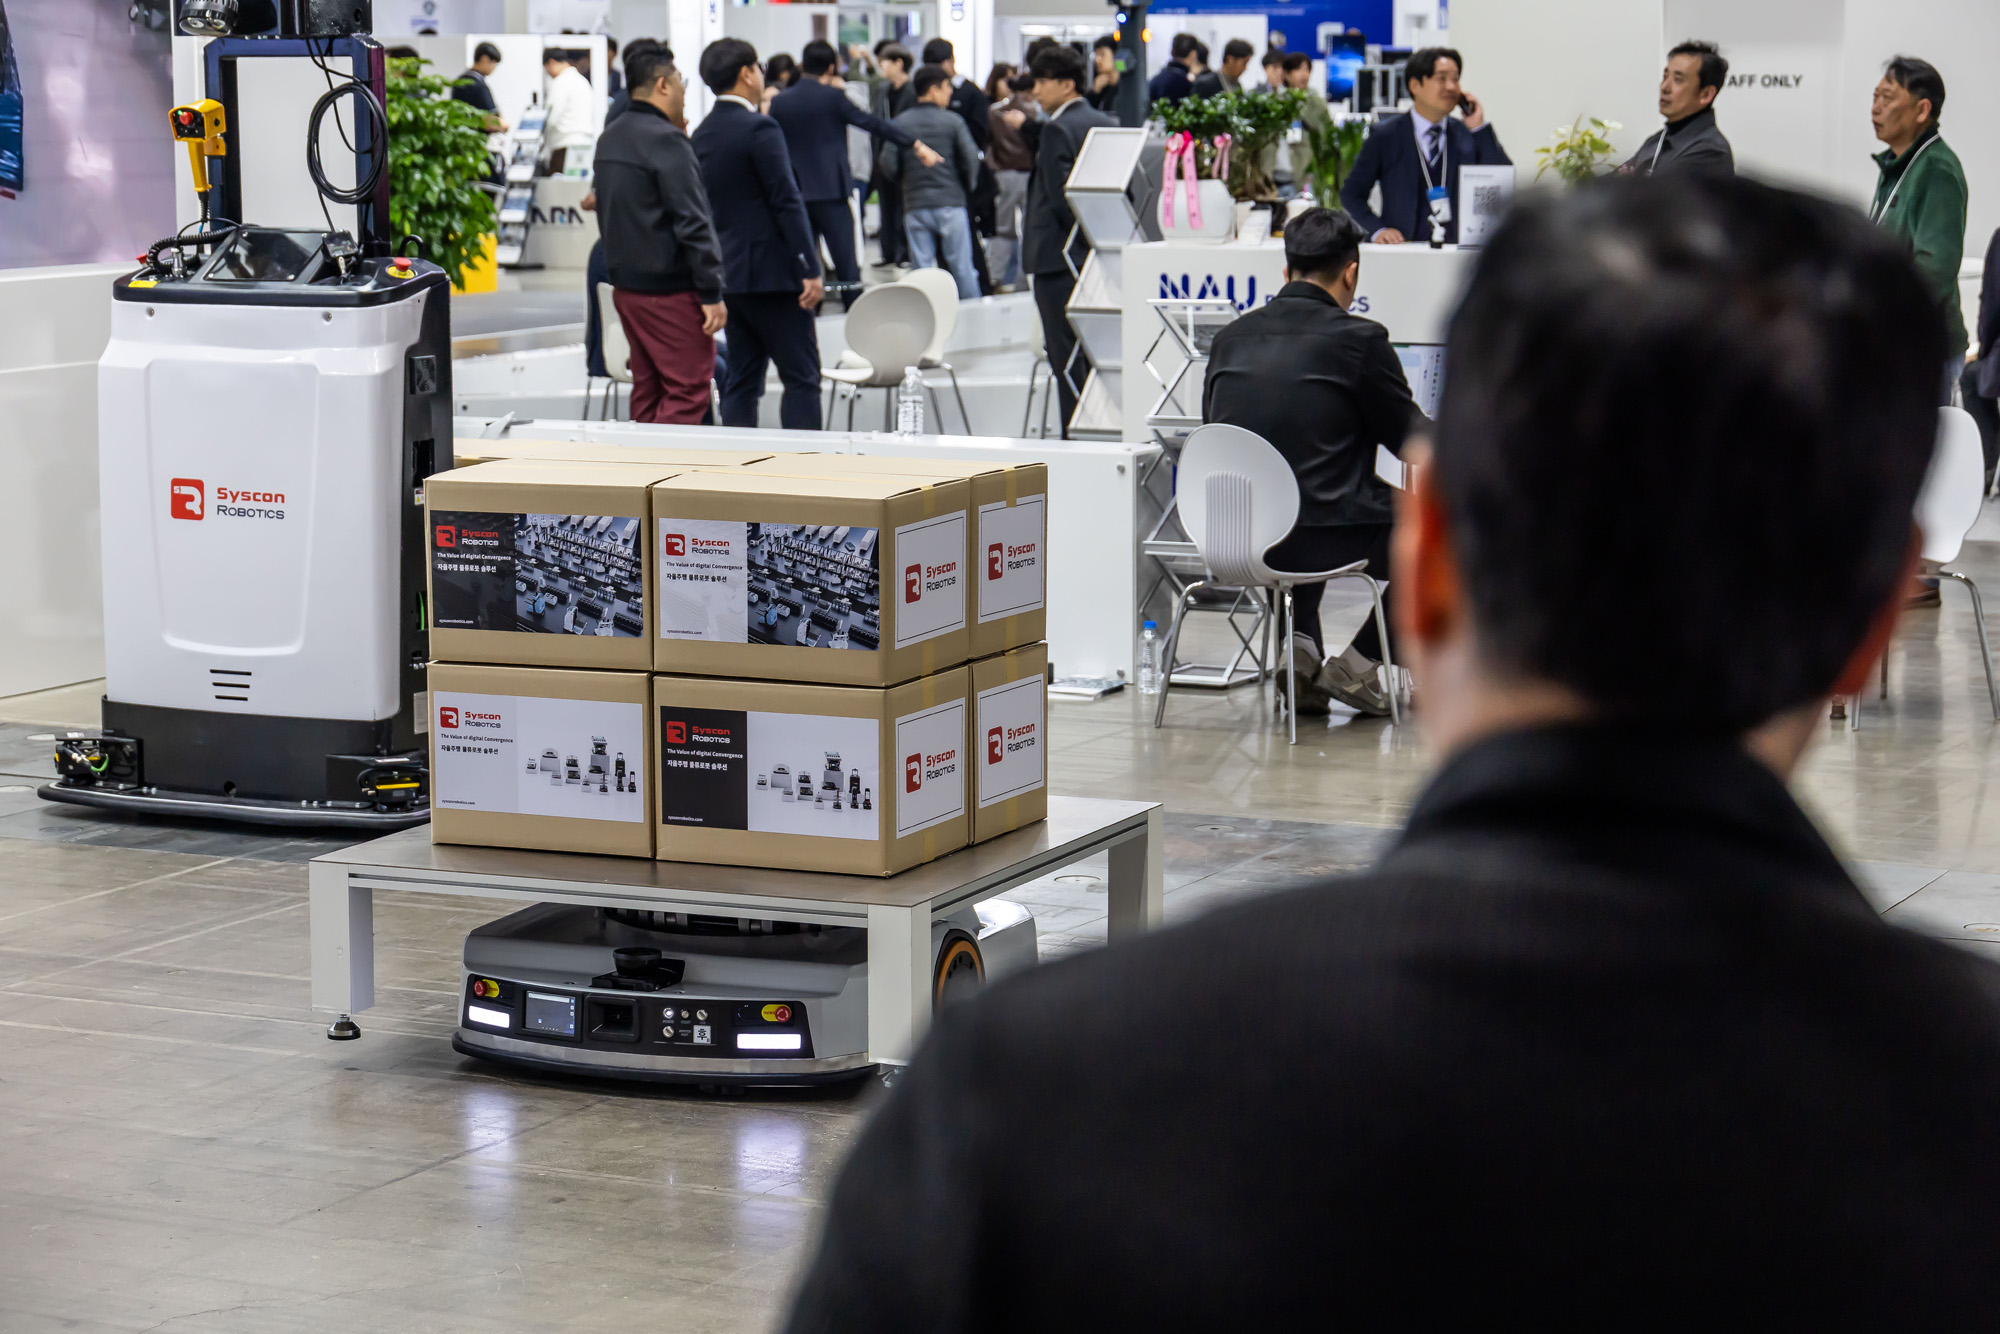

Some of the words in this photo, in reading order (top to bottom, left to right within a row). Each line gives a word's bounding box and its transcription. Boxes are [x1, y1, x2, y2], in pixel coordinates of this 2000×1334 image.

[1727, 74, 1756, 87] AFF
[1760, 74, 1803, 88] ONLY
[217, 487, 285, 503] Syscon
[217, 505, 285, 519] ROBOTICS
[461, 529, 499, 538] Syscon
[461, 538, 499, 546] ROBOTICS
[691, 538, 730, 547] Syscon
[691, 547, 730, 555] ROBOTICS
[1007, 543, 1036, 558] Syscon
[695, 562, 711, 570] digital
[926, 561, 956, 579] Syscon
[1007, 557, 1035, 571] ROBOTICS
[926, 576, 956, 592] ROBOTICS
[465, 711, 501, 720] Syscon
[465, 720, 501, 729] ROBOTICS
[692, 726, 730, 735] Syscon
[1007, 723, 1035, 740] Syscon
[692, 735, 731, 744] ROBOTICS
[1007, 737, 1035, 753] ROBOTICS
[712, 751, 744, 759] Convergence
[926, 749, 956, 767] Syscon
[926, 764, 956, 781] ROBOTICS
